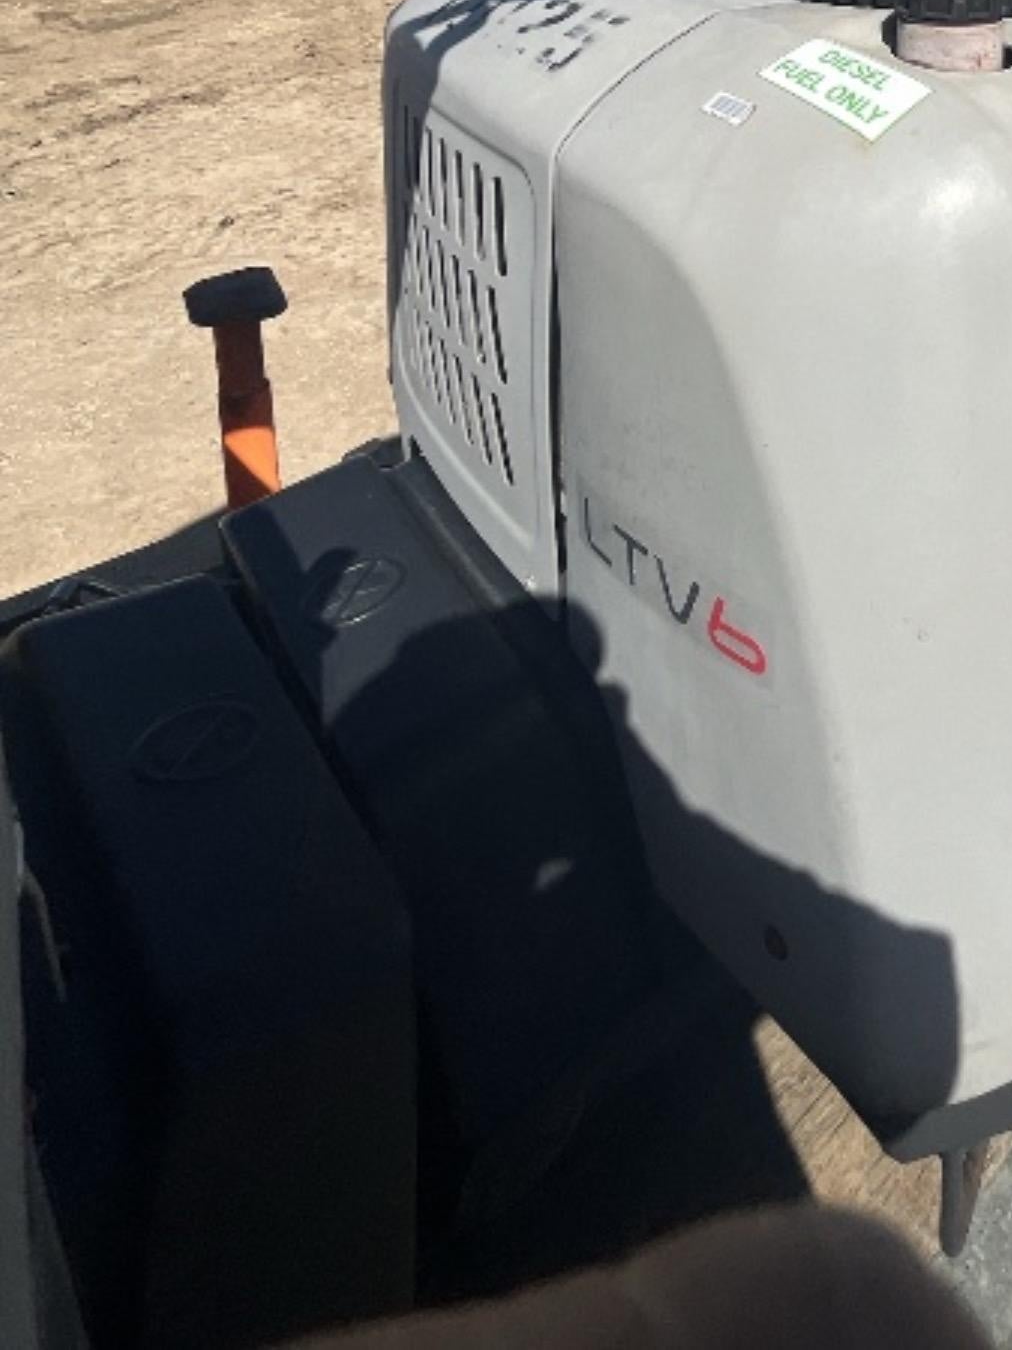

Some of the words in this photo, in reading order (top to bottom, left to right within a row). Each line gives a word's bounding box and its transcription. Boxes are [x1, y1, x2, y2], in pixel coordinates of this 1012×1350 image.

[773, 59, 825, 94] FUEL
[824, 84, 889, 125] ONLY
[818, 49, 892, 92] DIESEL
